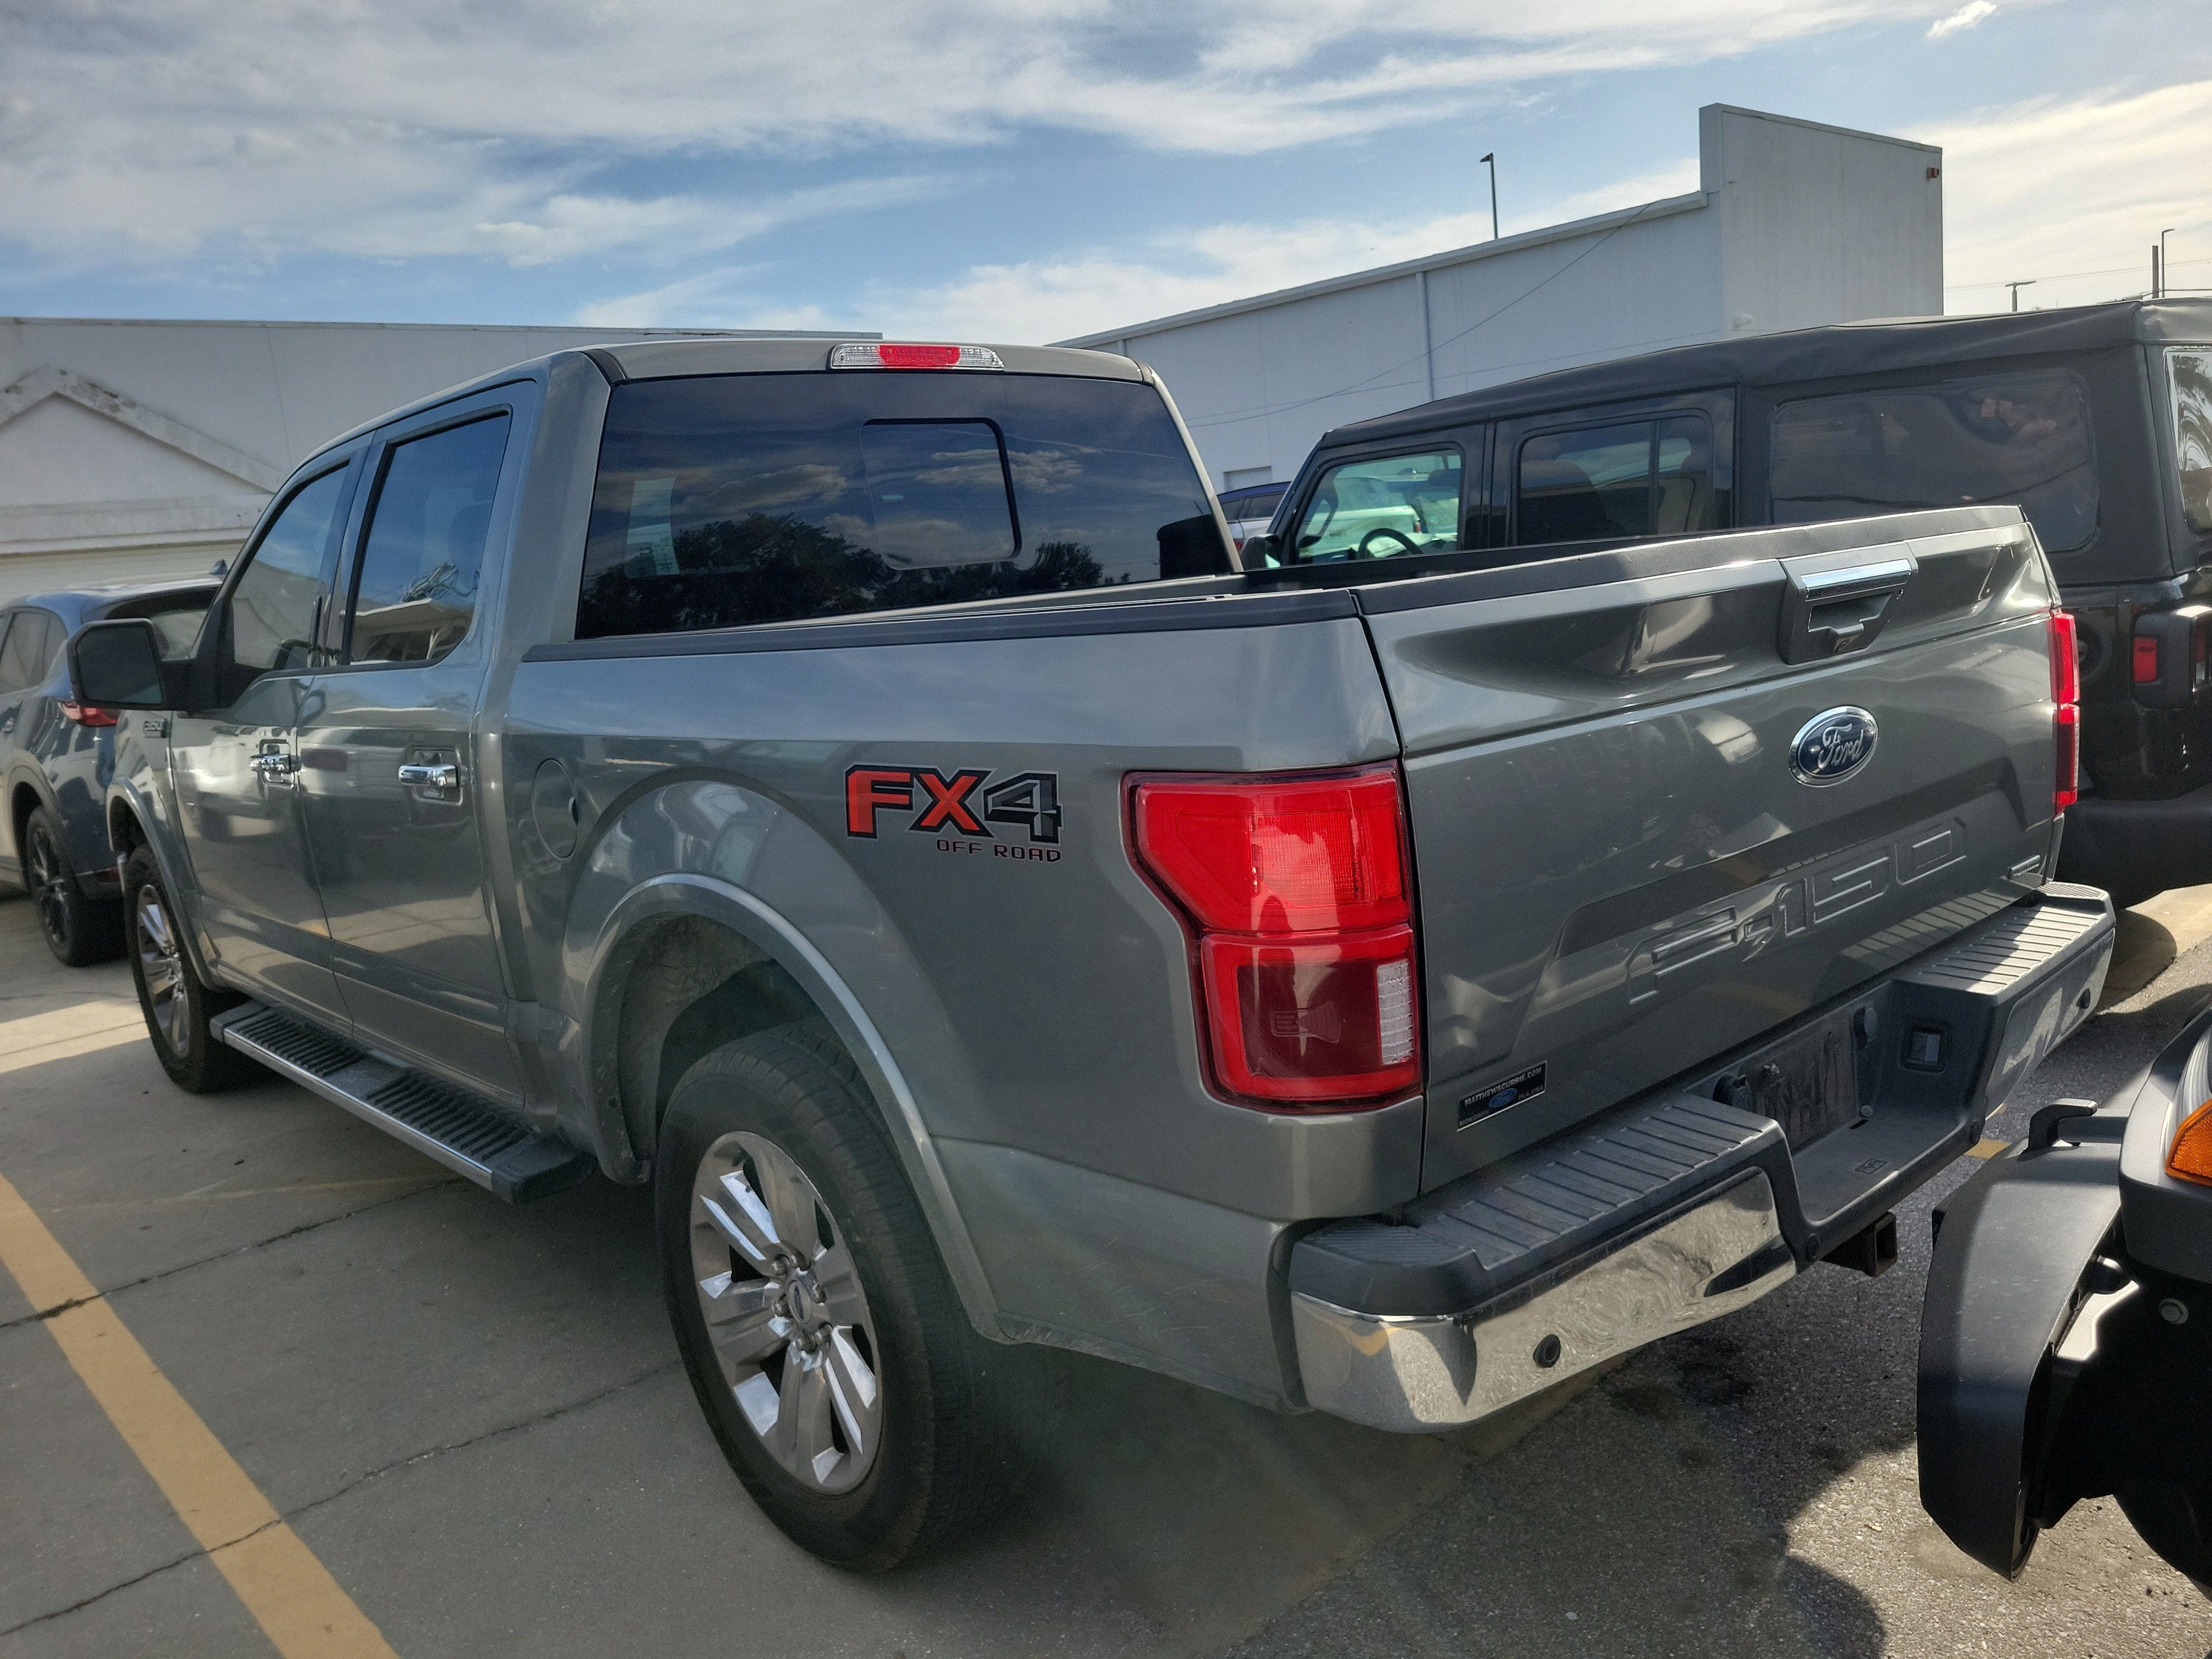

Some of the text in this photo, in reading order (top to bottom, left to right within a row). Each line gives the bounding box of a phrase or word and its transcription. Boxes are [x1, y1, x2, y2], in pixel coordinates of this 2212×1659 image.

[1817, 722, 1864, 769] Ford
[845, 764, 1063, 845] FX4
[936, 839, 1062, 862] OFF ROAD
